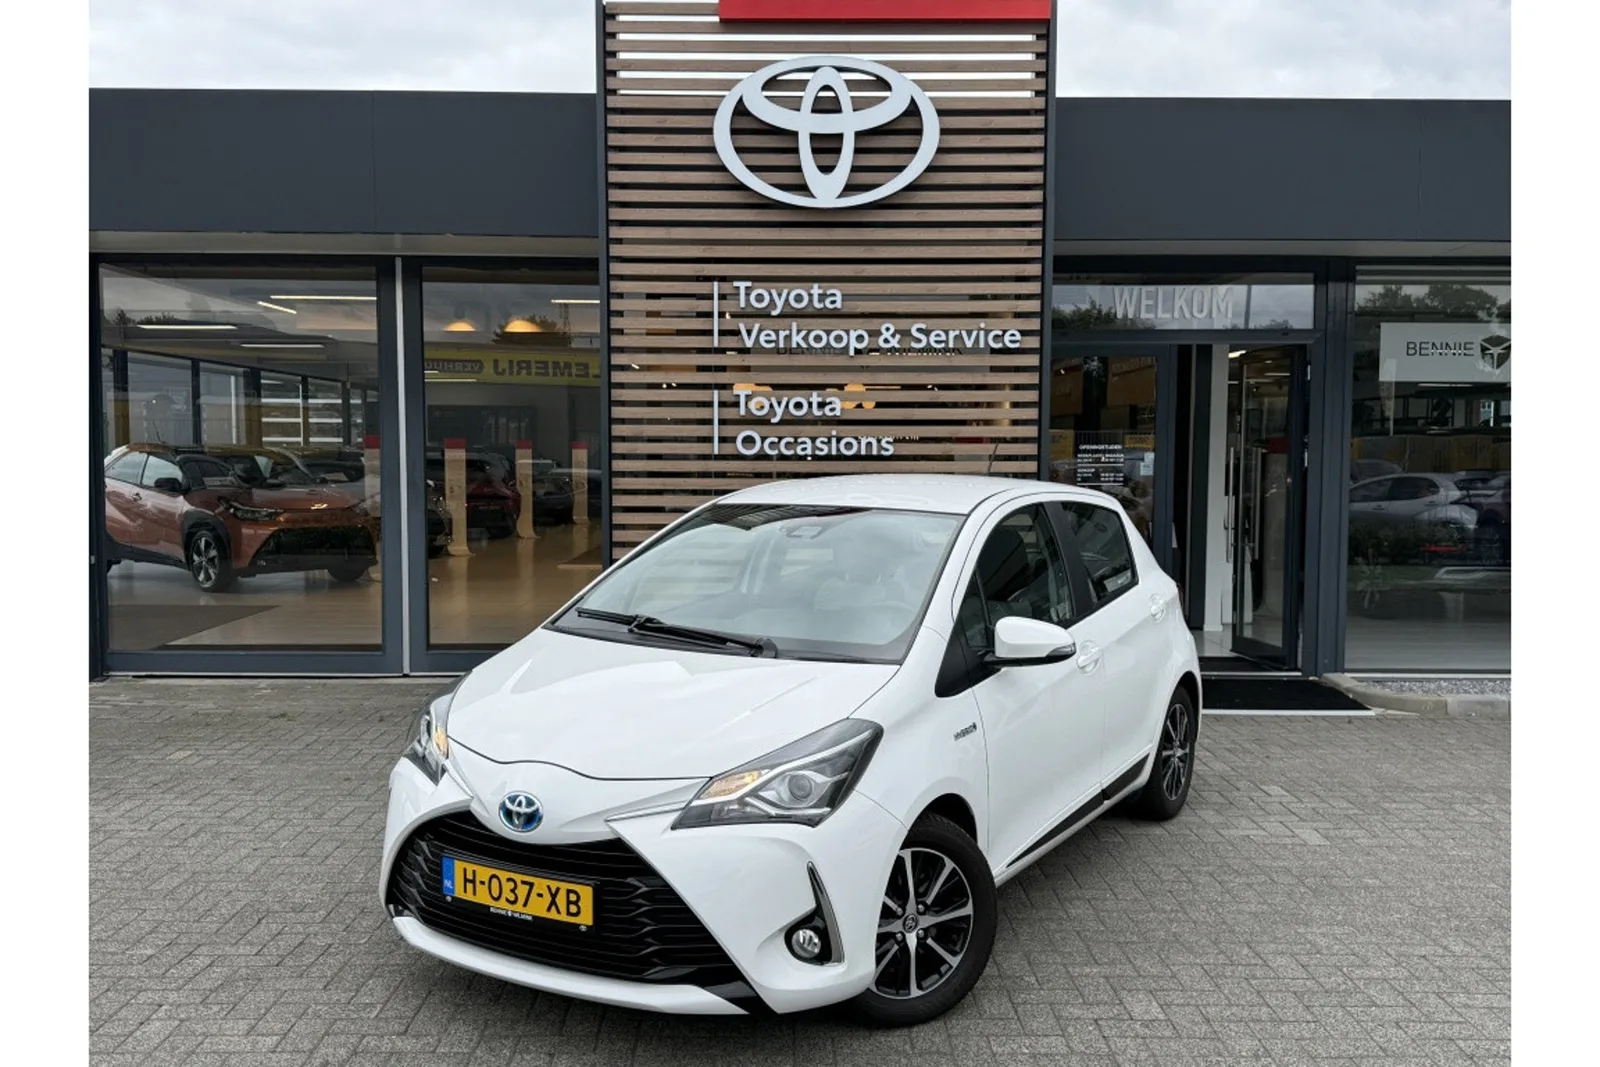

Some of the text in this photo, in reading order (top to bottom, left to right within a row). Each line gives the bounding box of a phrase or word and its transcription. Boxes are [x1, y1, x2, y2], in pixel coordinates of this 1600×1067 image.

[733, 281, 843, 316] Toyota
[1112, 286, 1233, 319] WELKOM
[738, 322, 1022, 356] Verkoop & Service
[1406, 341, 1475, 356] BENNIE
[733, 391, 841, 423] Toyota
[735, 430, 894, 456] Occasions
[463, 867, 582, 918] H-037-XB
